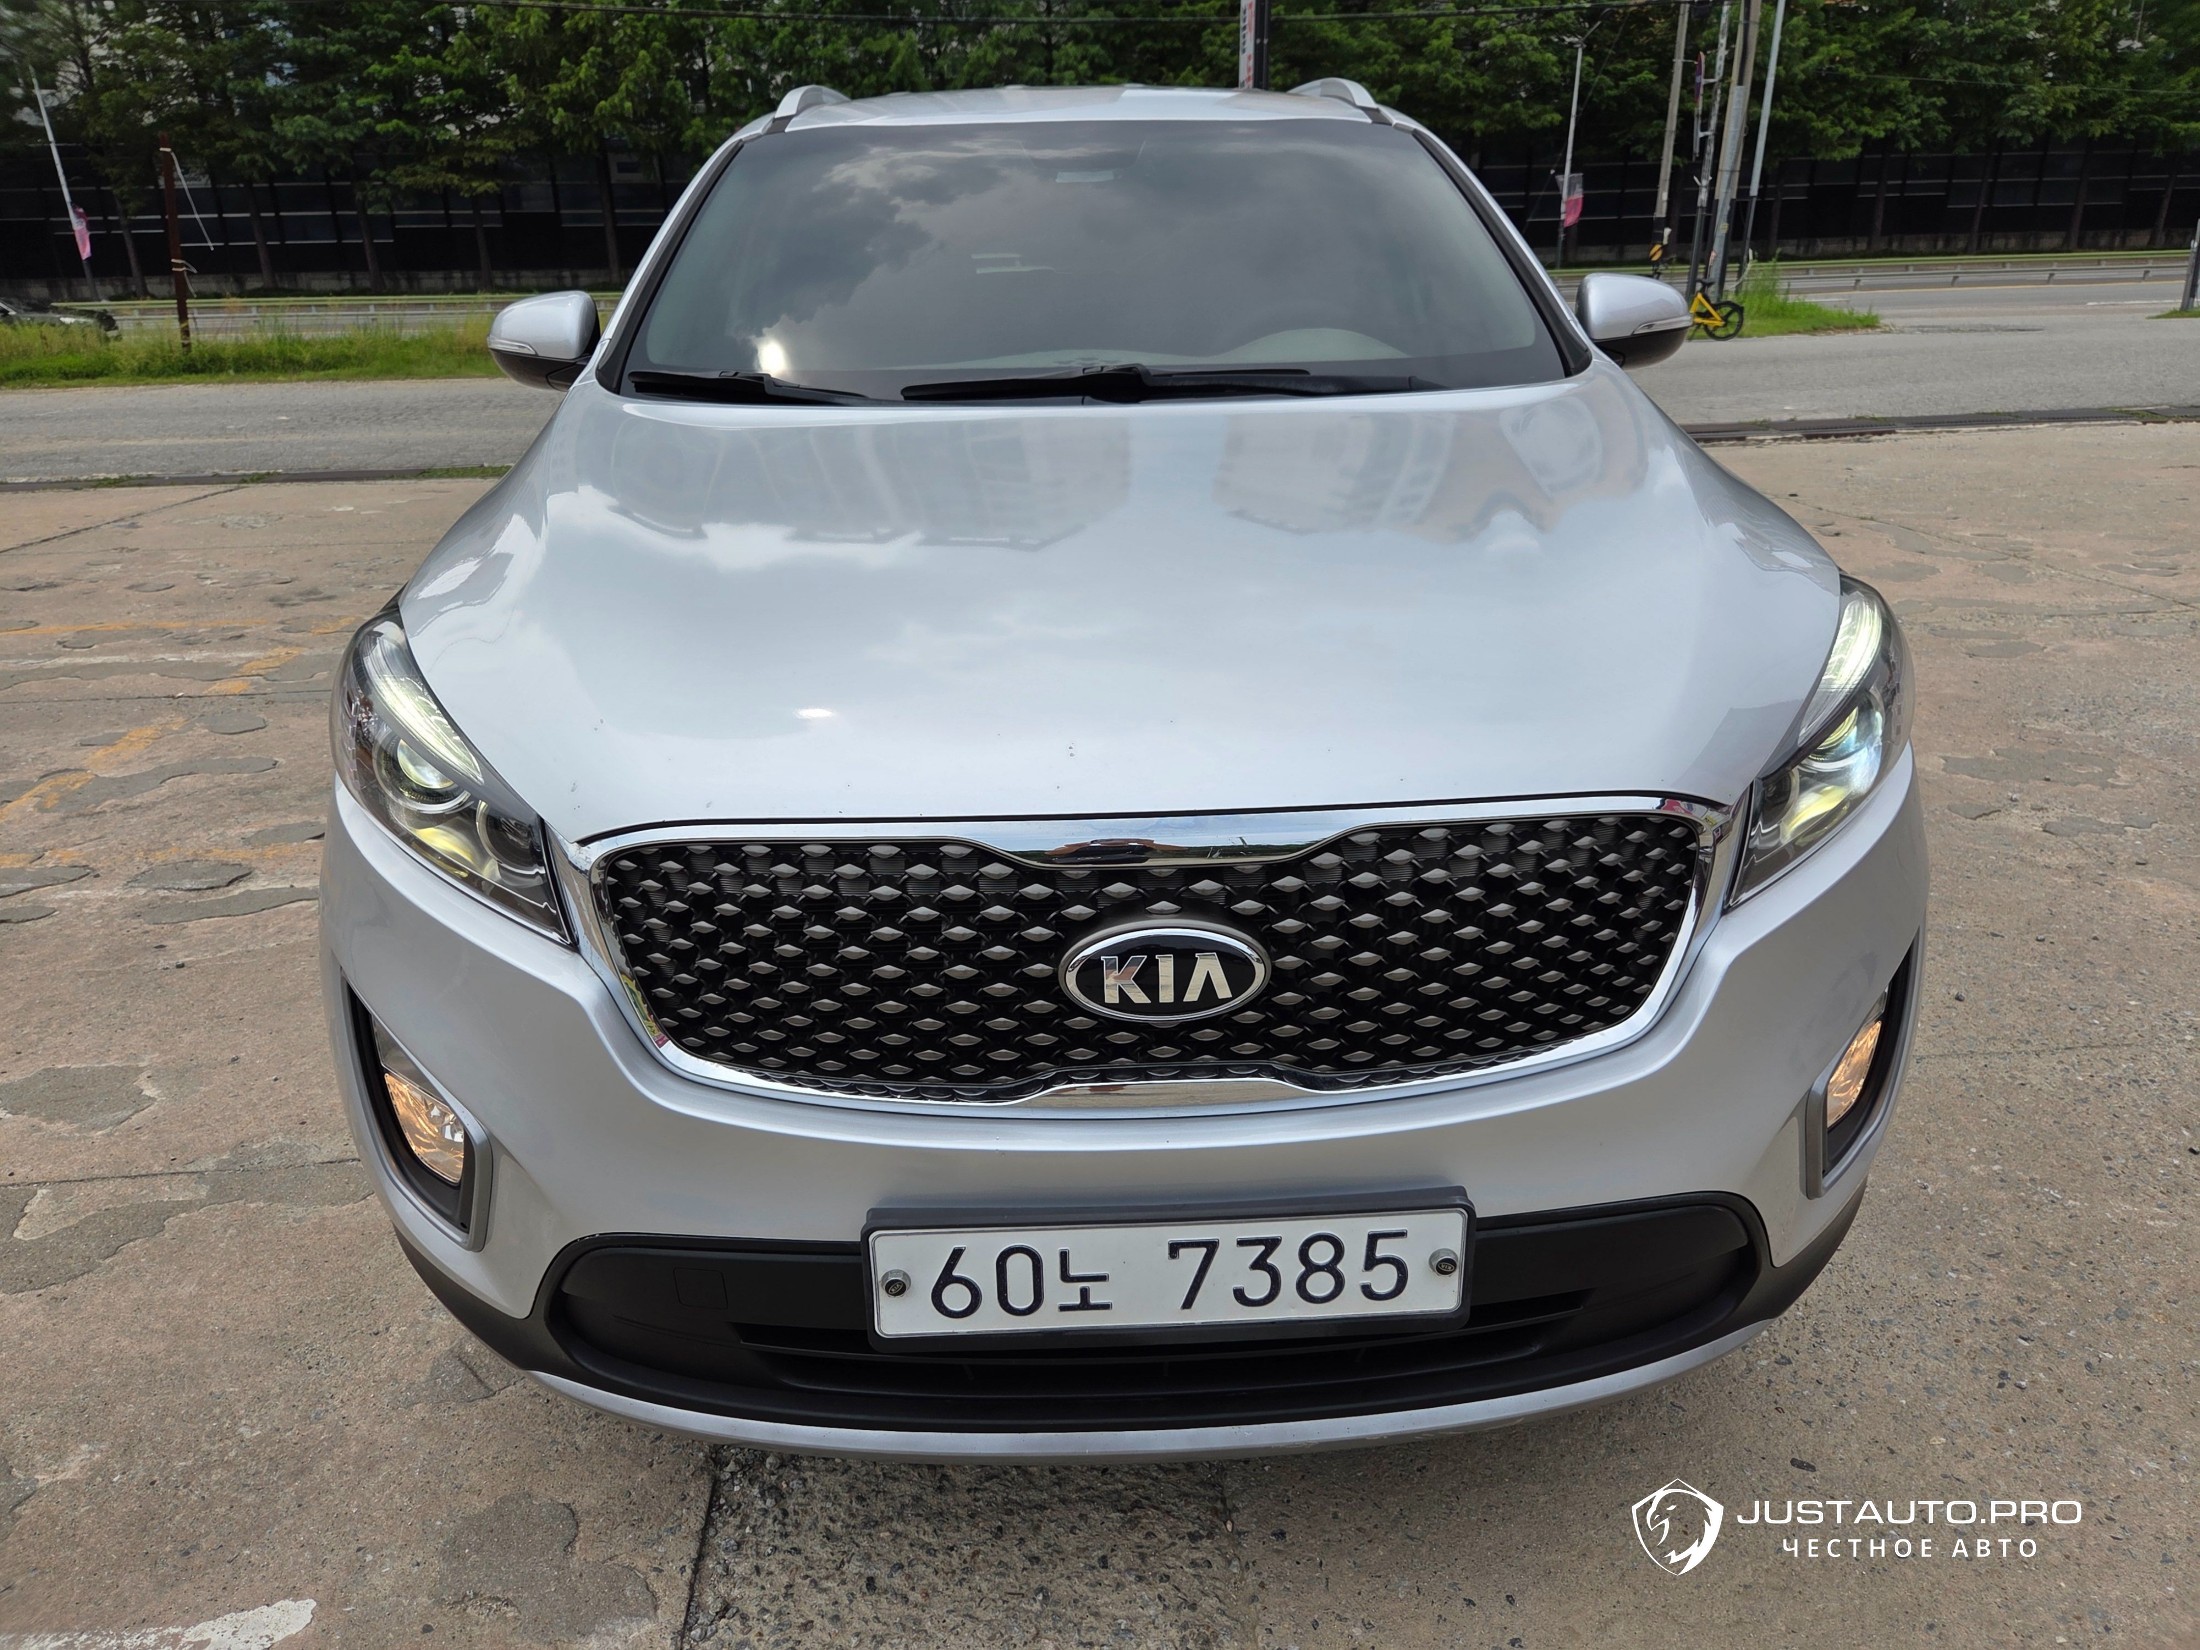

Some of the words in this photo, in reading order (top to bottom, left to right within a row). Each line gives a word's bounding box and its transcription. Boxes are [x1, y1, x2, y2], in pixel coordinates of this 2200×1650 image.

[1101, 952, 1232, 1004] KIA
[931, 1245, 1112, 1319] 60노
[1167, 1229, 1408, 1310] 7385
